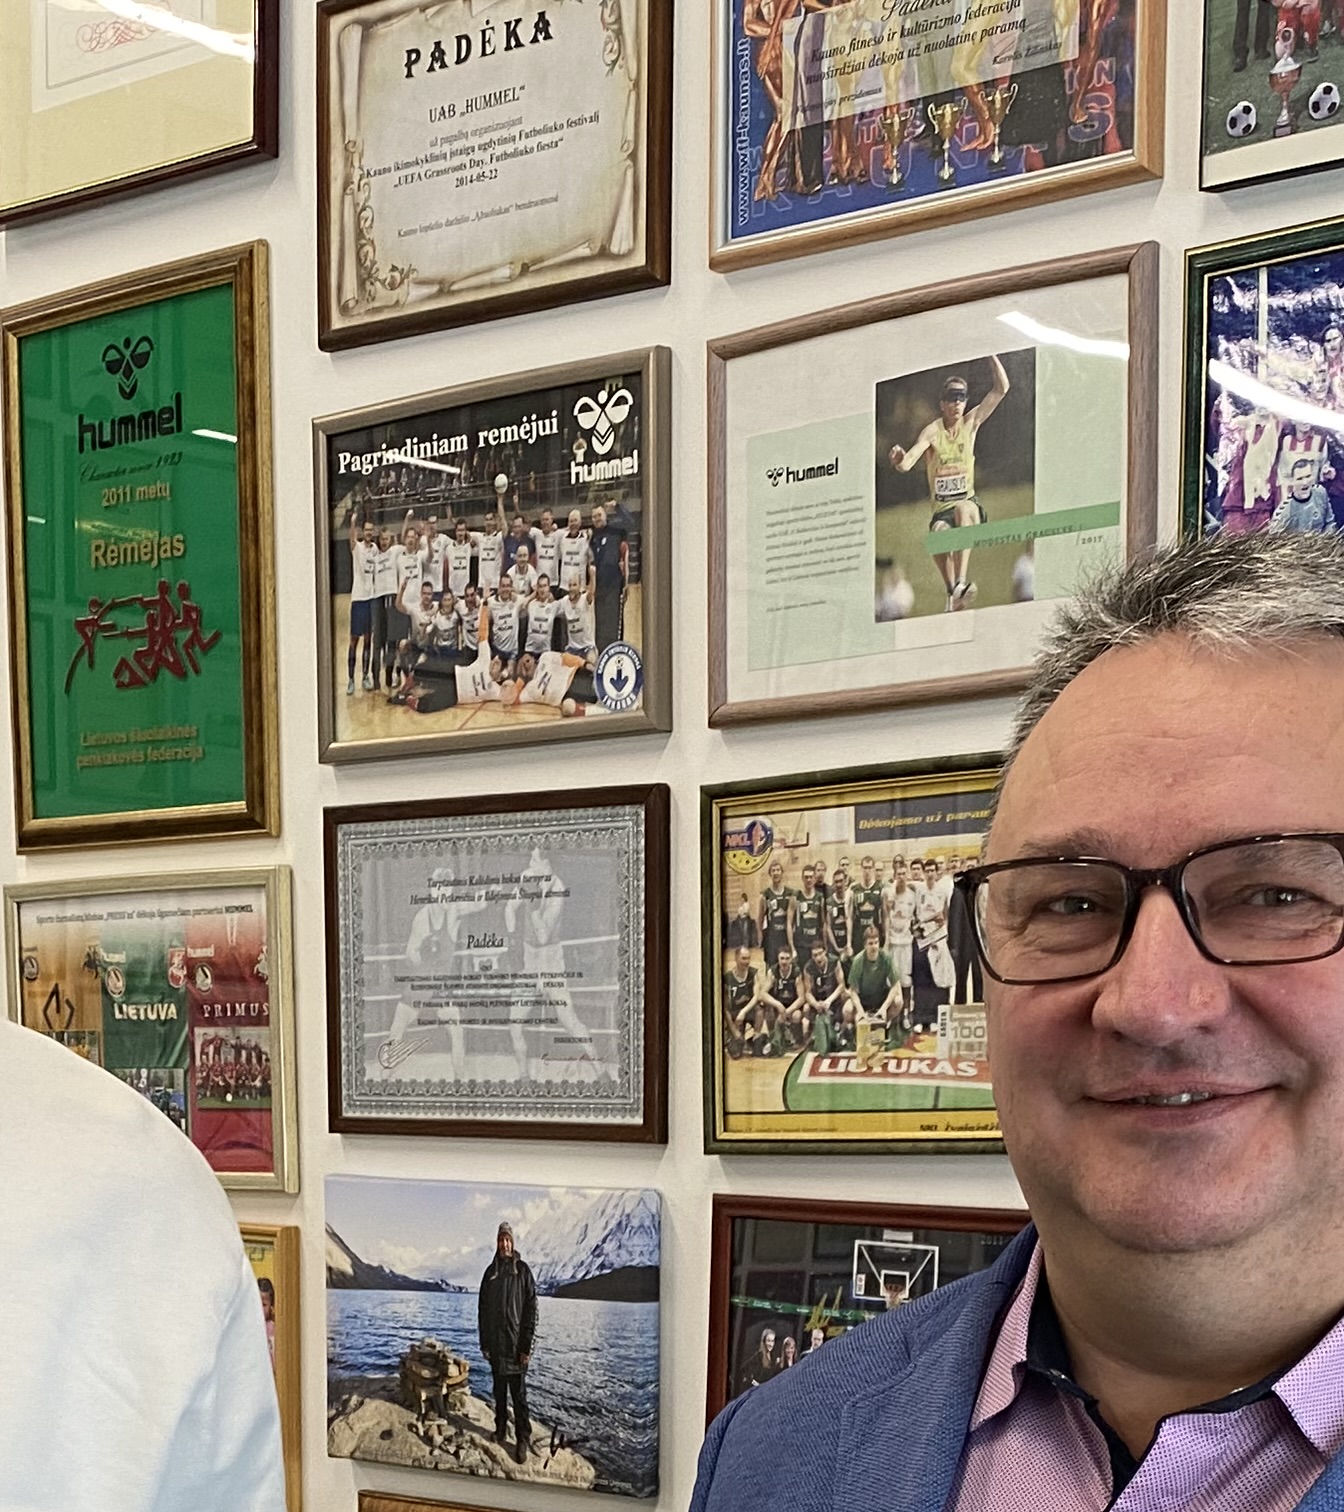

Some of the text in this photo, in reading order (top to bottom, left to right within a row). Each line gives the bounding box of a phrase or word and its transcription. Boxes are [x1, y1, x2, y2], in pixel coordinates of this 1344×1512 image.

[404, 10, 554, 79] PADĖKA
[806, 17, 1027, 86] nuoširdžiai dėkoja už nuolatinę paramą
[810, 43, 845, 63] Kauno
[848, 31, 884, 57] fitneso
[887, 27, 898, 41] ir
[899, 13, 962, 40] kultūrizmo
[429, 85, 526, 124] UAB „HUMMEL“
[366, 164, 392, 179] Kauno
[518, 121, 564, 142] Futboliuko
[566, 110, 600, 130] festivalį
[490, 146, 535, 166] Futboliuko
[455, 168, 499, 188] 2014-05-22
[78, 391, 184, 454] hummel
[338, 410, 560, 476] Pagrindiniam remėjui
[570, 448, 640, 486] hummel
[786, 457, 840, 485] hummel
[102, 480, 172, 508] 2011 metų
[90, 533, 186, 570] Rėmėjas
[1081, 535, 1104, 546] 2017
[466, 933, 504, 950] Padėka
[114, 1002, 178, 1021] LIETUVA
[203, 1002, 269, 1018] PRIMUS
